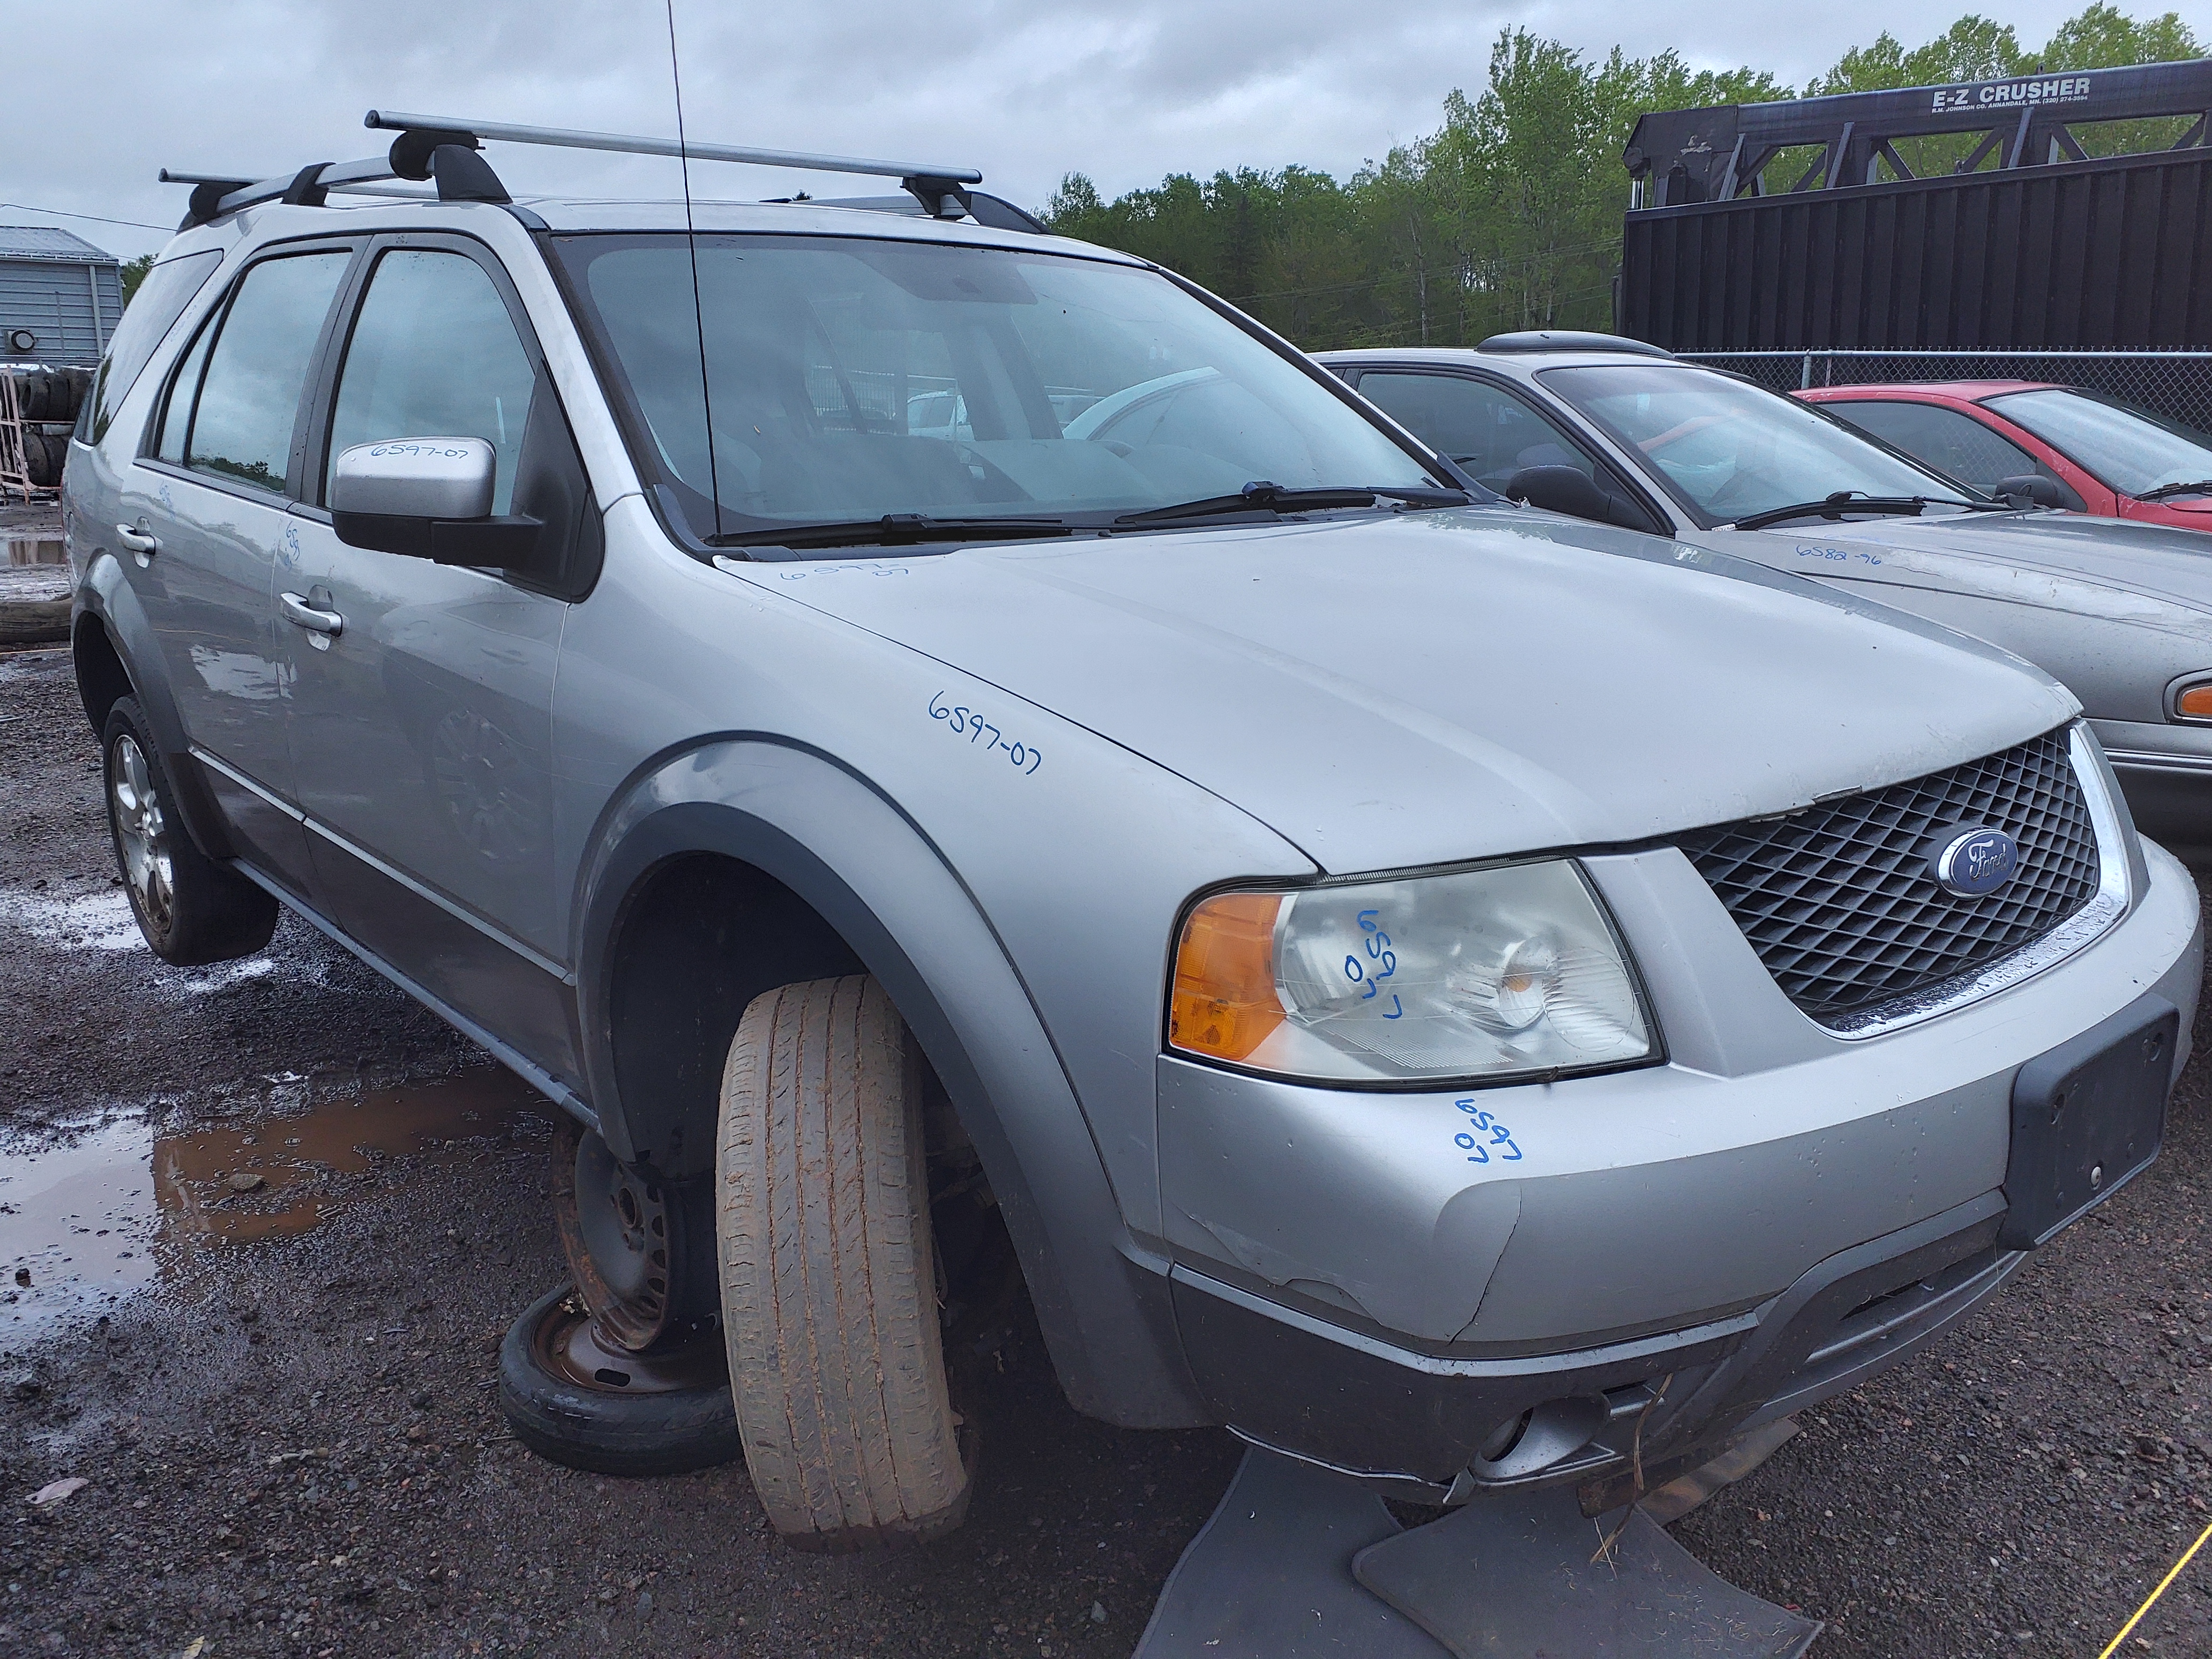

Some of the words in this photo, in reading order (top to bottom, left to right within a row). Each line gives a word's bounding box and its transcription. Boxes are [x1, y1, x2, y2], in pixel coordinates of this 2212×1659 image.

[1932, 88, 1969, 107] E-Z
[1979, 78, 2091, 103] CRUSHER
[1988, 100, 2028, 108] ANNANDALE,
[371, 444, 468, 459] 6597-07
[929, 690, 1042, 775] 6597-07
[1968, 839, 2007, 882] Ford
